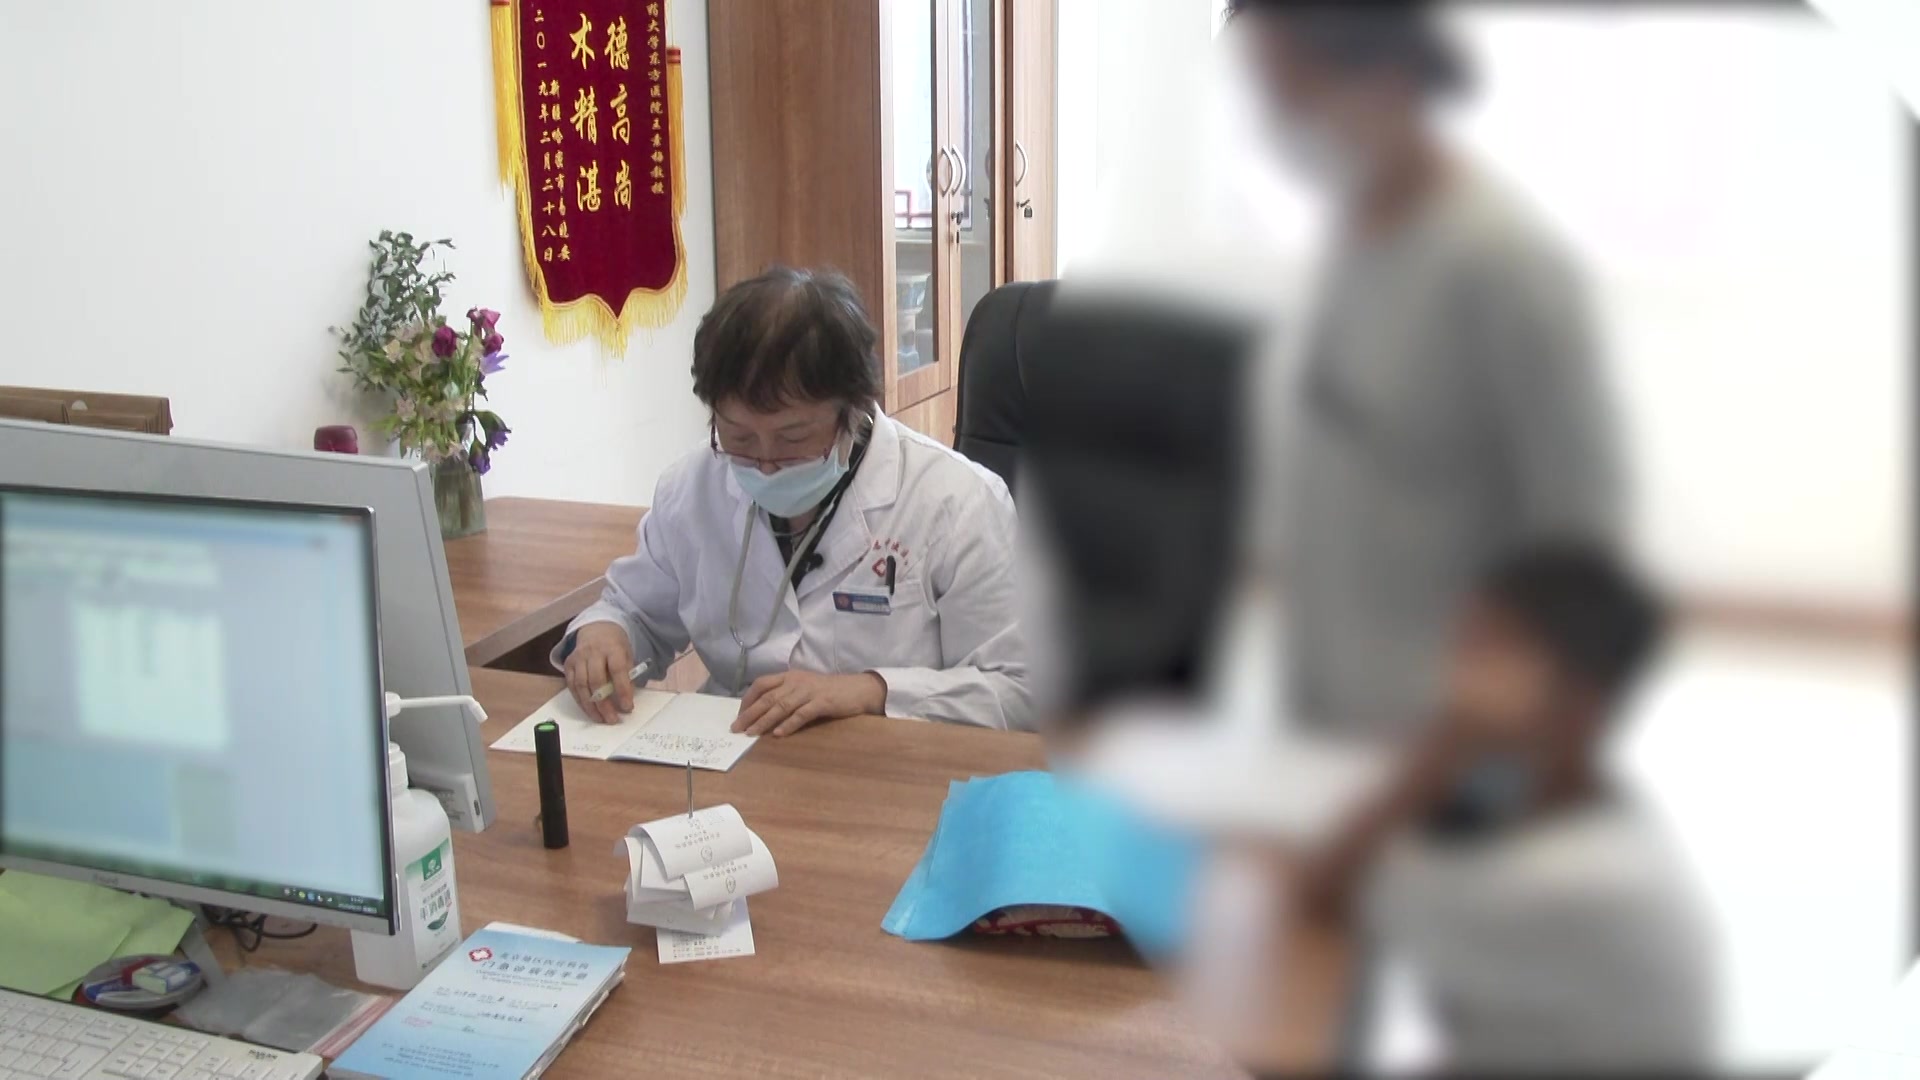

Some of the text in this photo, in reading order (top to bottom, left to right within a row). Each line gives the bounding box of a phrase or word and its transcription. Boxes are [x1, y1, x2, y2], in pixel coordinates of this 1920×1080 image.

[569, 12, 602, 212] 术精湛
[604, 16, 632, 211] 德高尚
